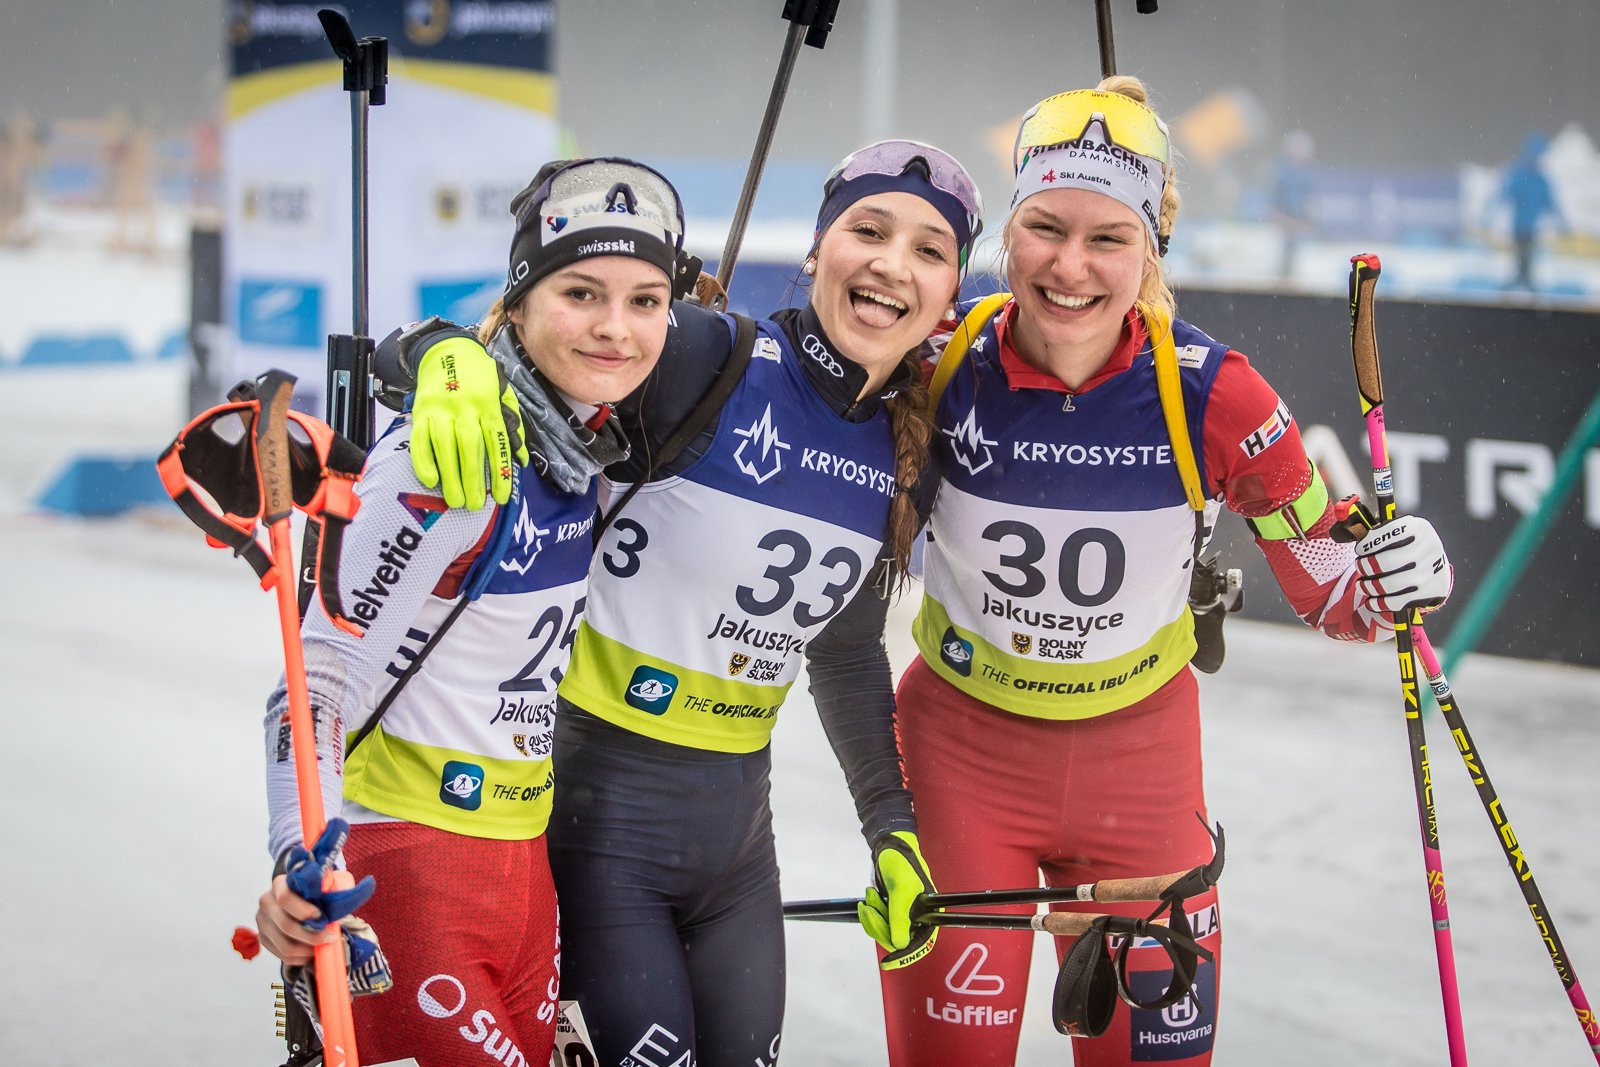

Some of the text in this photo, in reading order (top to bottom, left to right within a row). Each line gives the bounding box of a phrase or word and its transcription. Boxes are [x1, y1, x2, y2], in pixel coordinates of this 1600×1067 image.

[1077, 173, 1112, 186] Austria
[1013, 441, 1176, 466] KRYOSYSTE
[1362, 525, 1407, 553] ziener
[981, 519, 1126, 607] 30
[735, 528, 862, 629] 33
[982, 592, 1124, 637] Jakuszyce
[1039, 637, 1088, 650] DOLNY
[753, 659, 786, 673] DOLNY
[981, 654, 1159, 695] THE OFFICIAL IBU APP
[683, 695, 713, 713] THE
[711, 702, 767, 719] OFFICIAL
[493, 783, 521, 800] THE
[1139, 1023, 1213, 1045] Husqvarna
